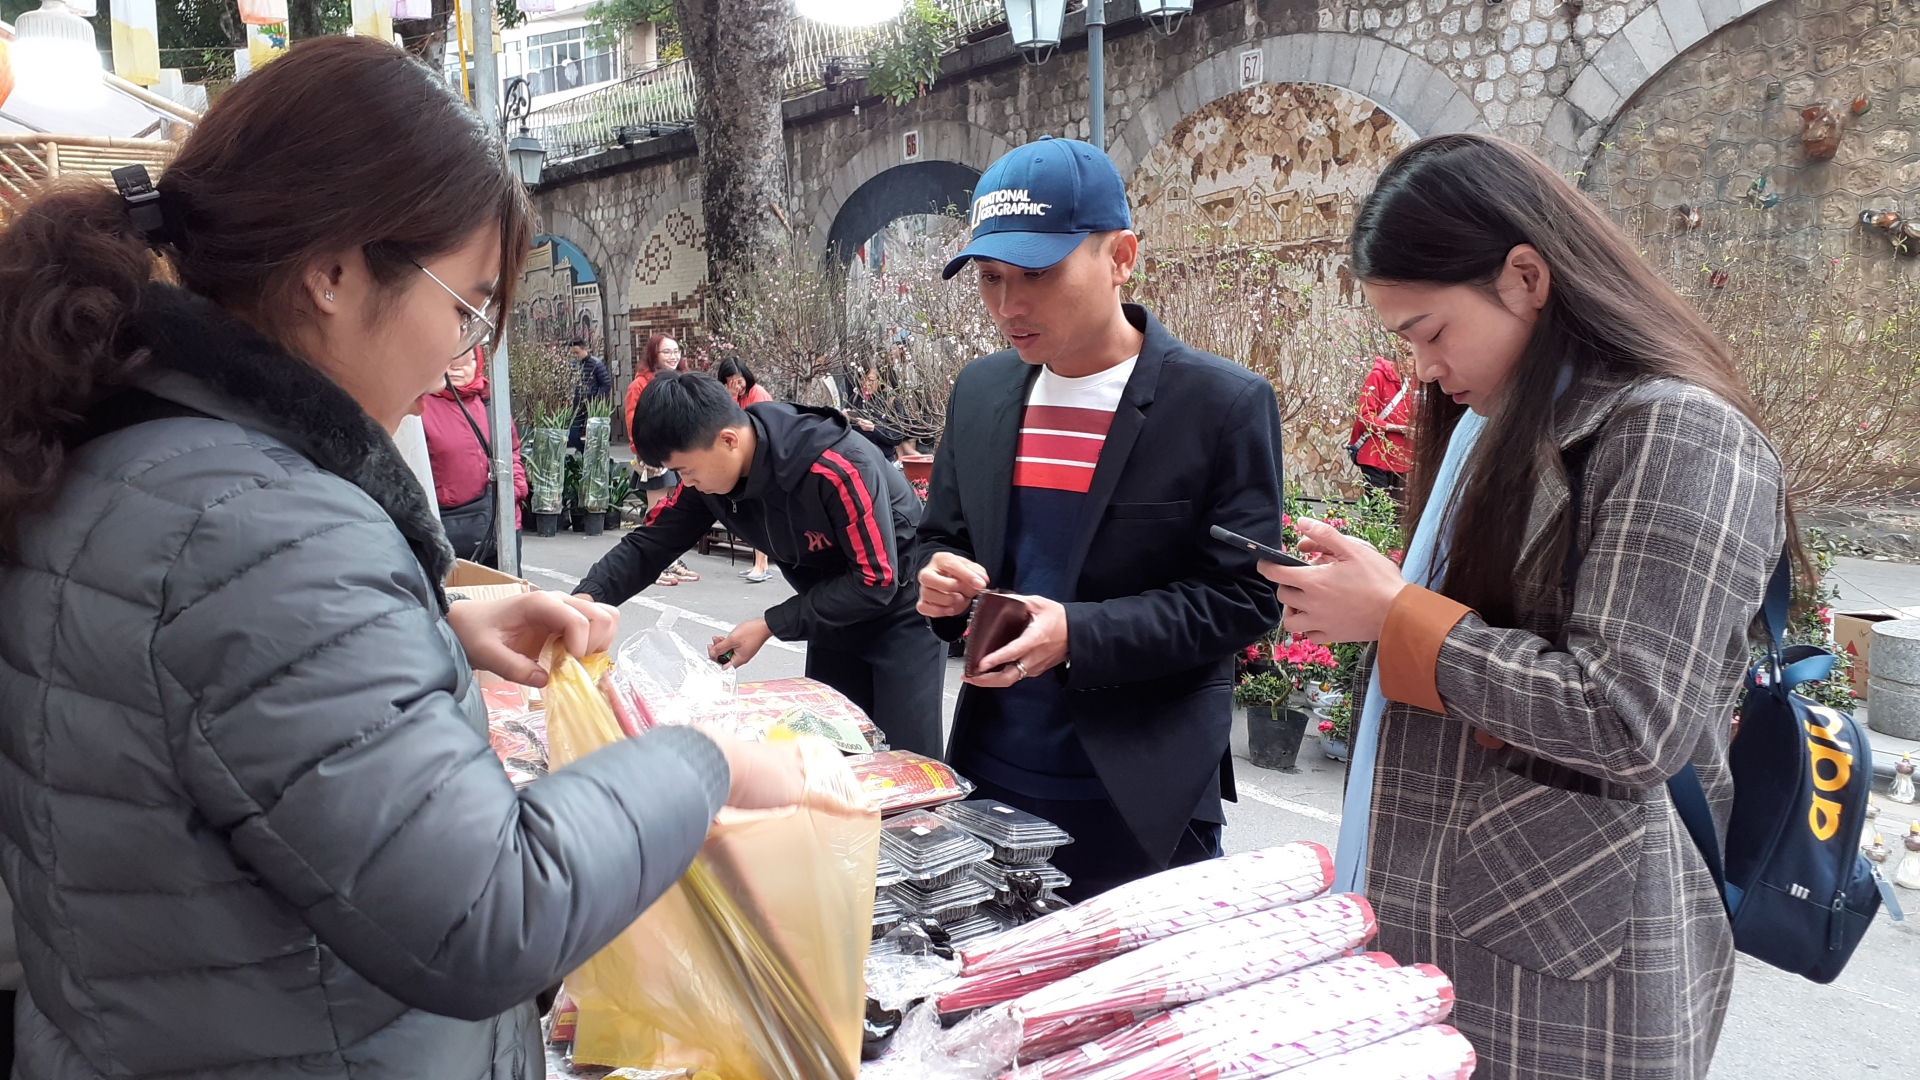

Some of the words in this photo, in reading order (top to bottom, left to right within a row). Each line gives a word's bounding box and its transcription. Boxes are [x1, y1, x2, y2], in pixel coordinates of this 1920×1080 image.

[1244, 55, 1258, 80] 67
[906, 134, 916, 157] 66
[981, 189, 1031, 207] NATIONAL
[981, 202, 1046, 220] GEOGRAPHIC
